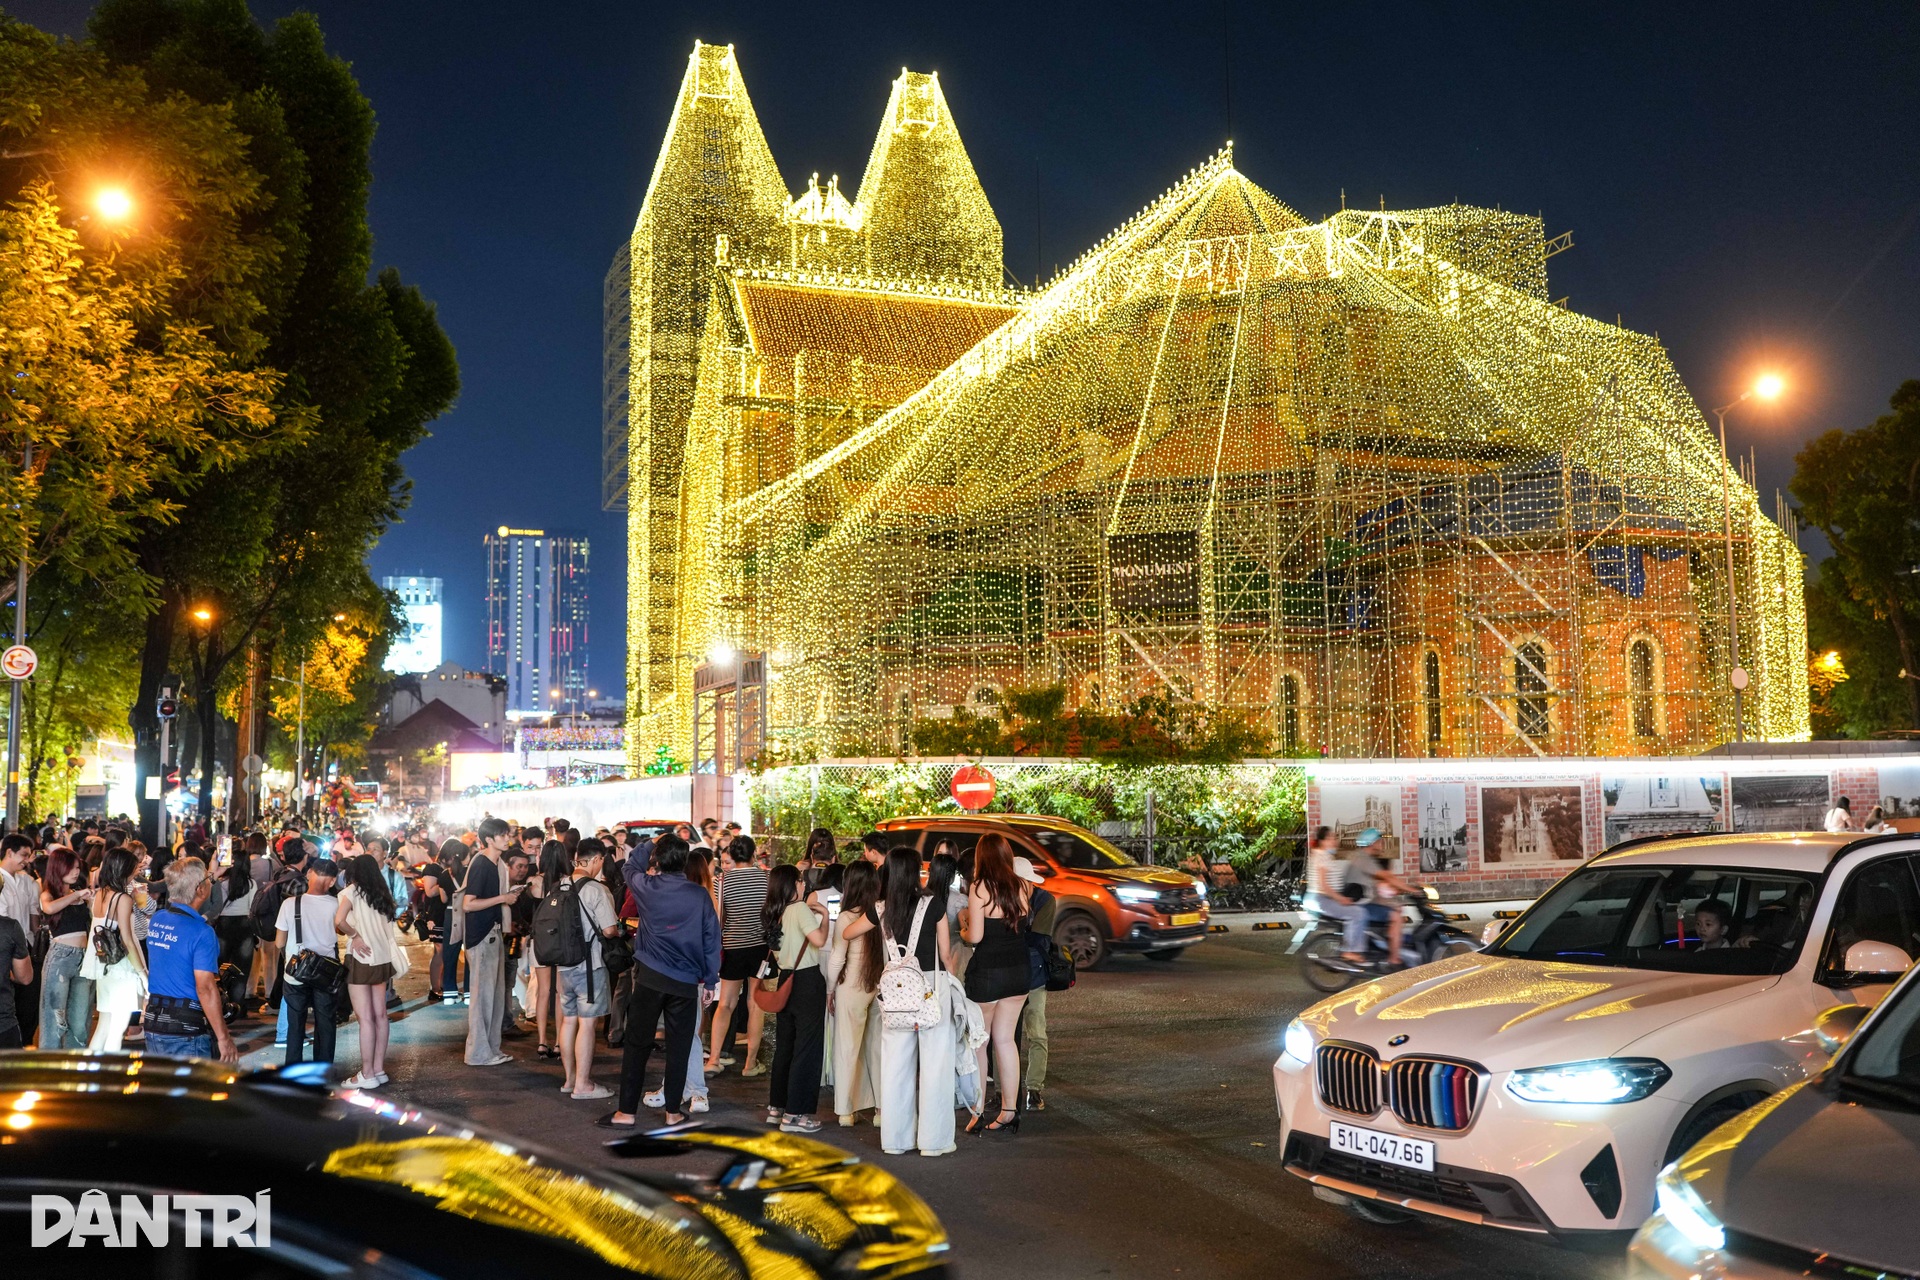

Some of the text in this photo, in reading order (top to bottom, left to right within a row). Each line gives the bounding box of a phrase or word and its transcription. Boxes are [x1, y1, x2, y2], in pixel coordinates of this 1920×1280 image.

[1112, 562, 1195, 578] MONUMENT
[160, 931, 165, 939] 7
[164, 933, 178, 943] plus
